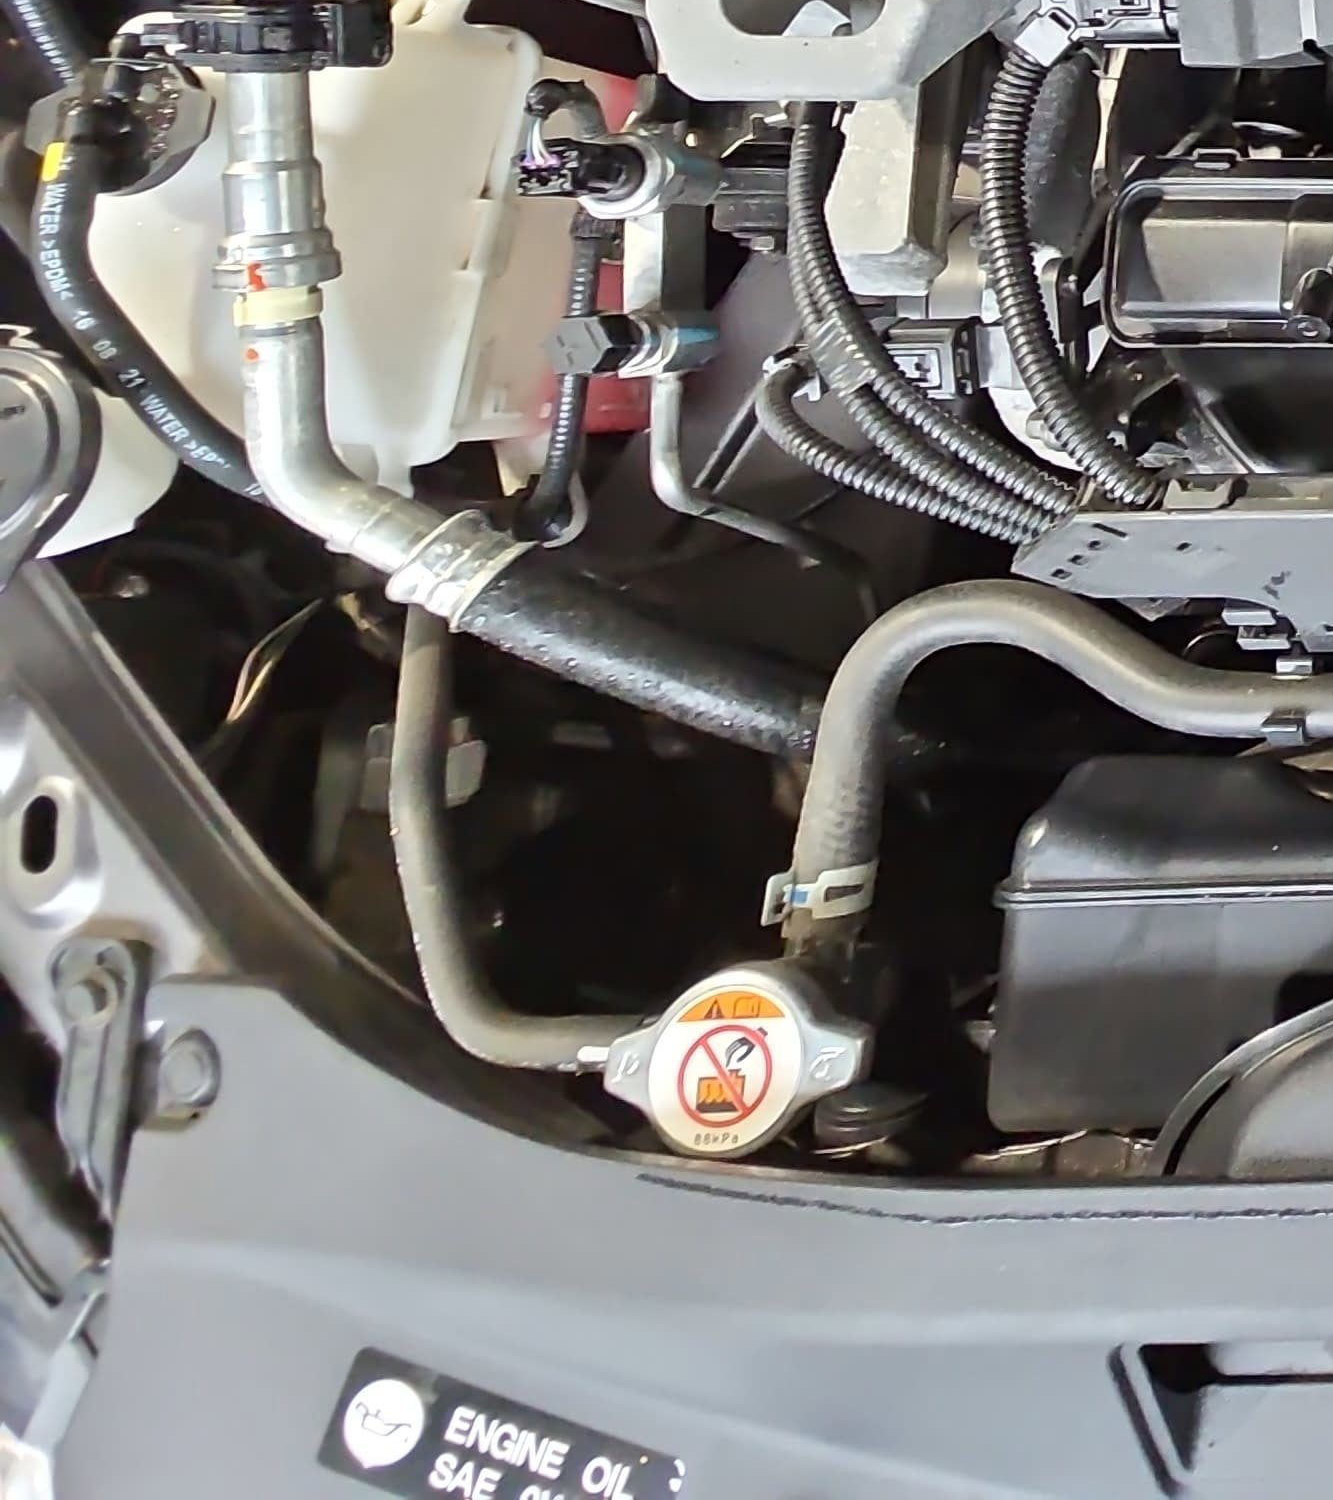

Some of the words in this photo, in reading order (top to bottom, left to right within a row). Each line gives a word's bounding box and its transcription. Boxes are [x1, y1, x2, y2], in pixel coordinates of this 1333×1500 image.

[39, 183, 67, 235] WATER
[117, 368, 145, 389] 21
[139, 394, 190, 444] WATER
[428, 1453, 502, 1500] SAE
[445, 1406, 571, 1480] ENGINE
[582, 1458, 635, 1499] OIL
